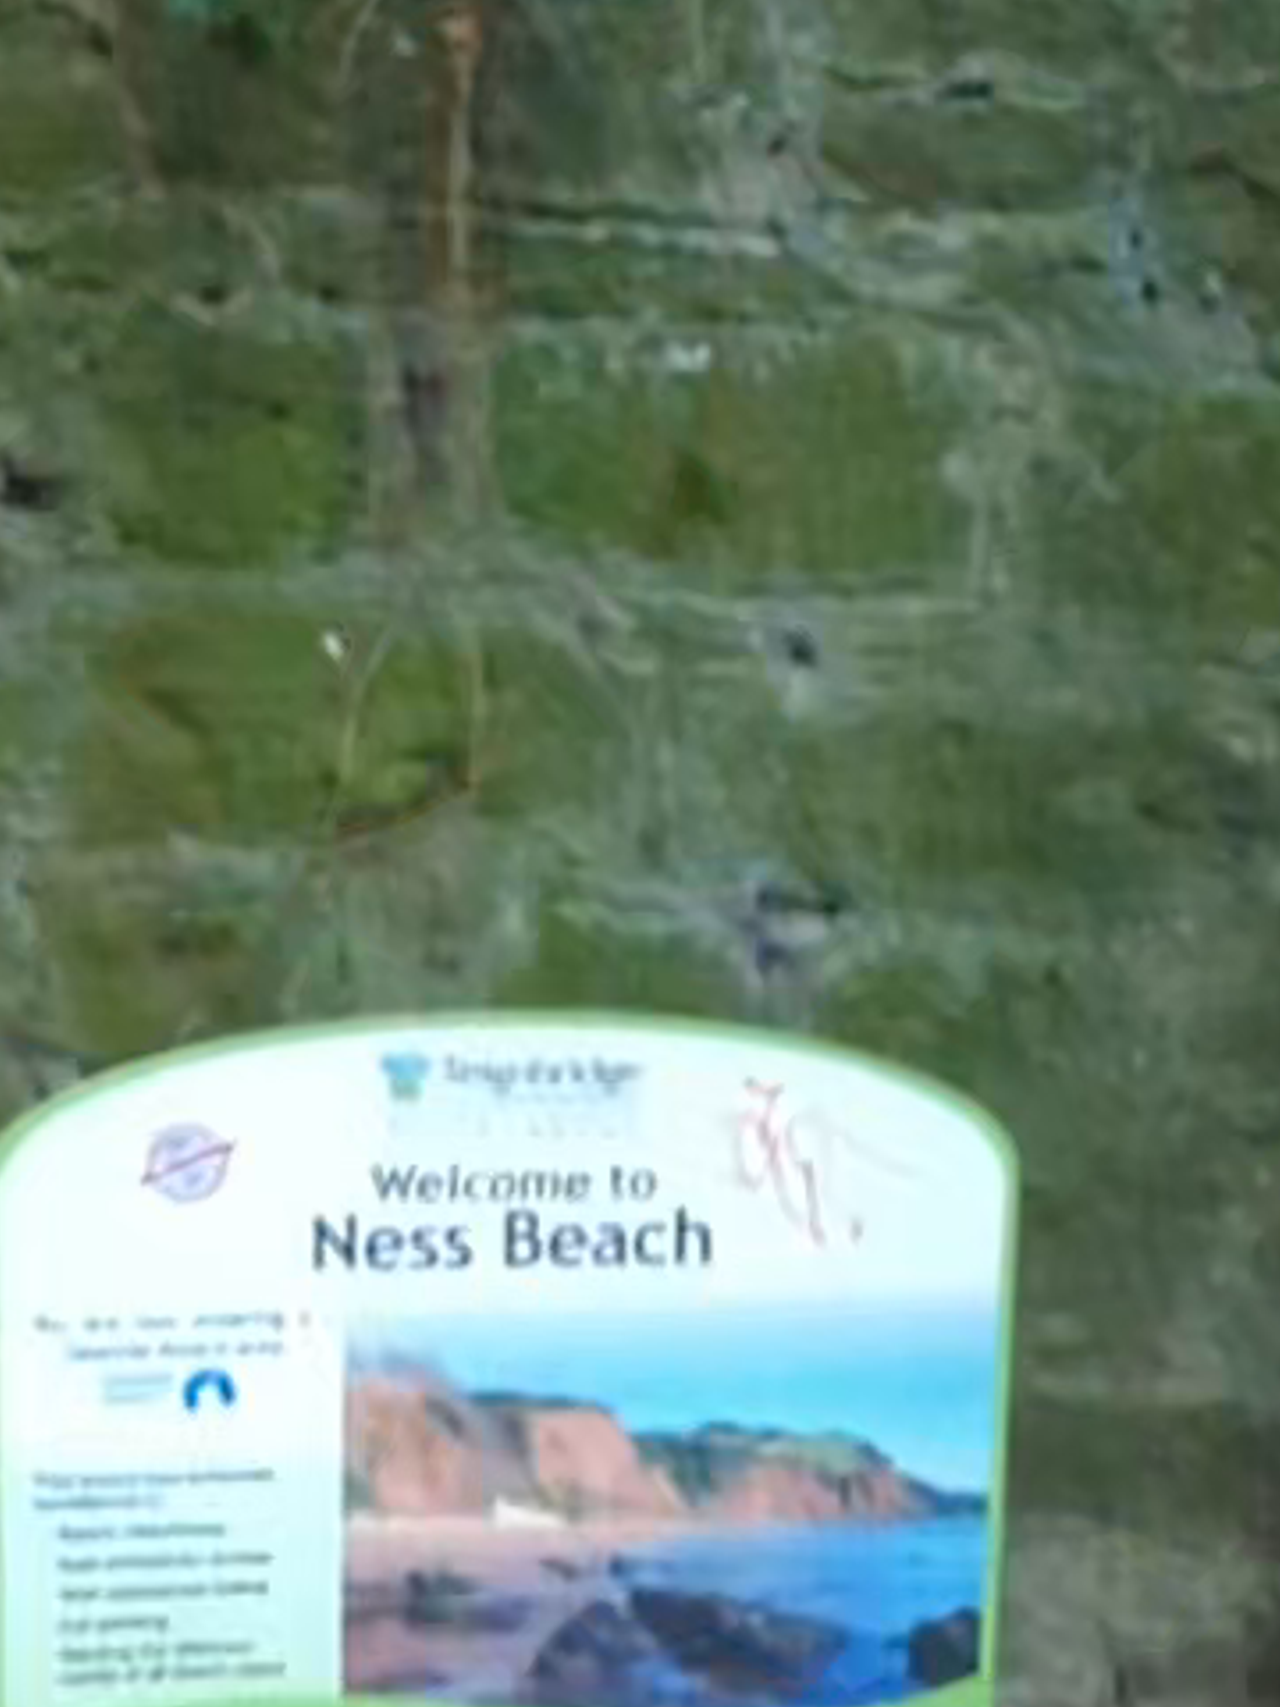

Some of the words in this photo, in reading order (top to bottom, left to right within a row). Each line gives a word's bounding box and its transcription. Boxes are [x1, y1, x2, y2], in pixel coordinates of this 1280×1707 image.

[370, 1162, 593, 1203] Welcome
[609, 1164, 658, 1203] to
[311, 1211, 474, 1272] Ness
[502, 1204, 715, 1270] Beach
